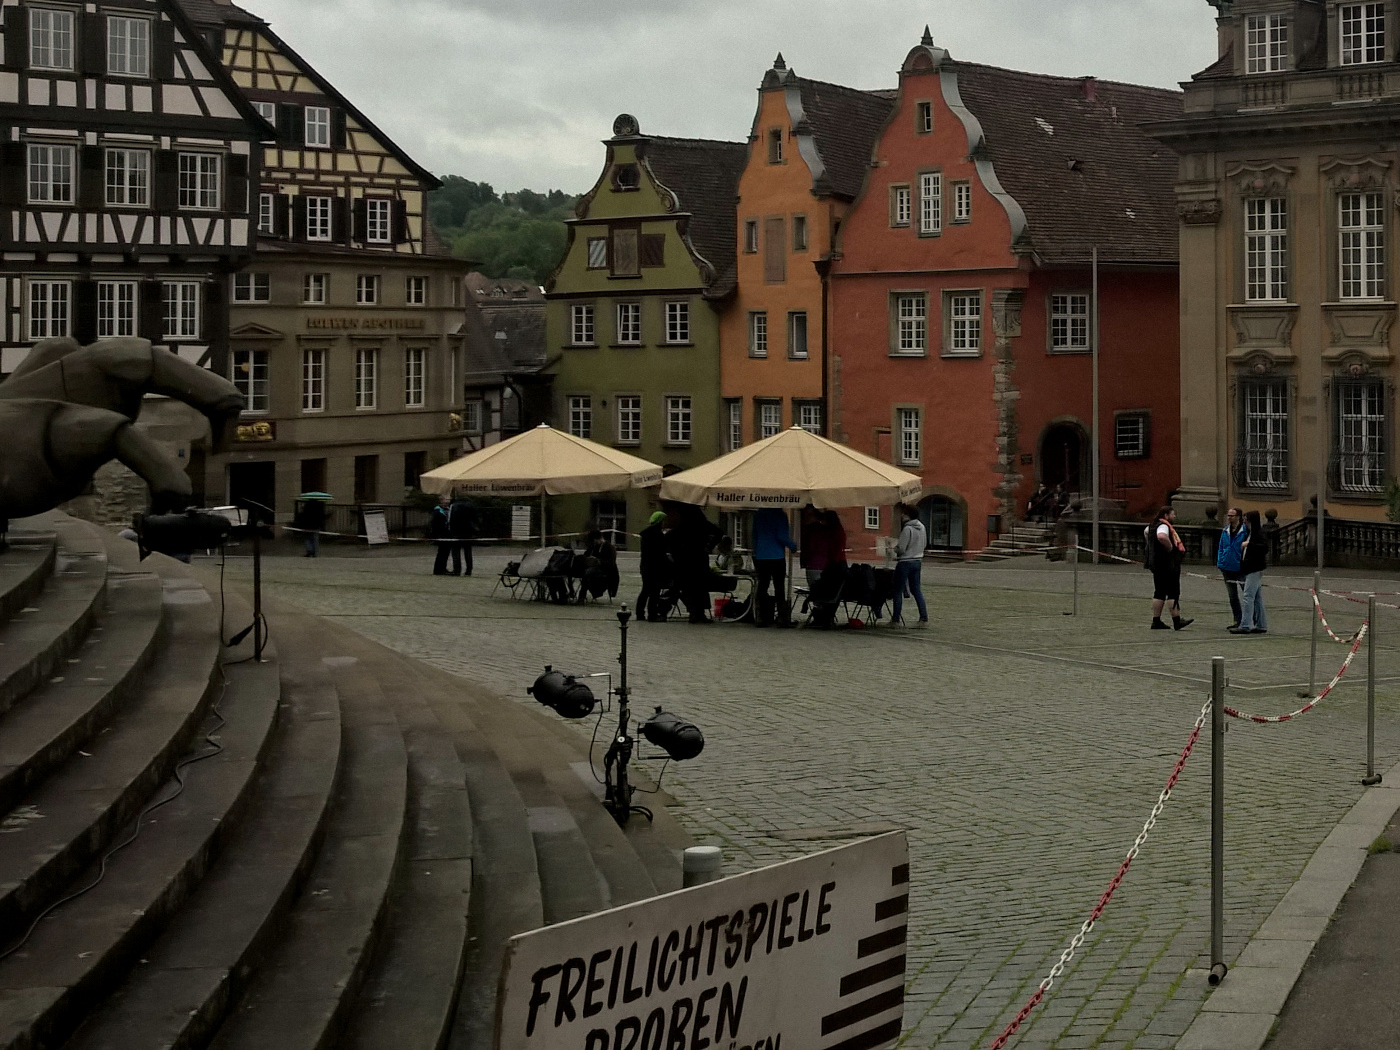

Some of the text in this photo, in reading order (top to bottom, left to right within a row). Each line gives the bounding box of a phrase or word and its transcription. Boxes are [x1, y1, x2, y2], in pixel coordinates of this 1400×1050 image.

[461, 483, 488, 492] Haller
[716, 492, 801, 503] Haller Löwenbräu
[525, 881, 837, 1038] FREILICHTSPIELE
